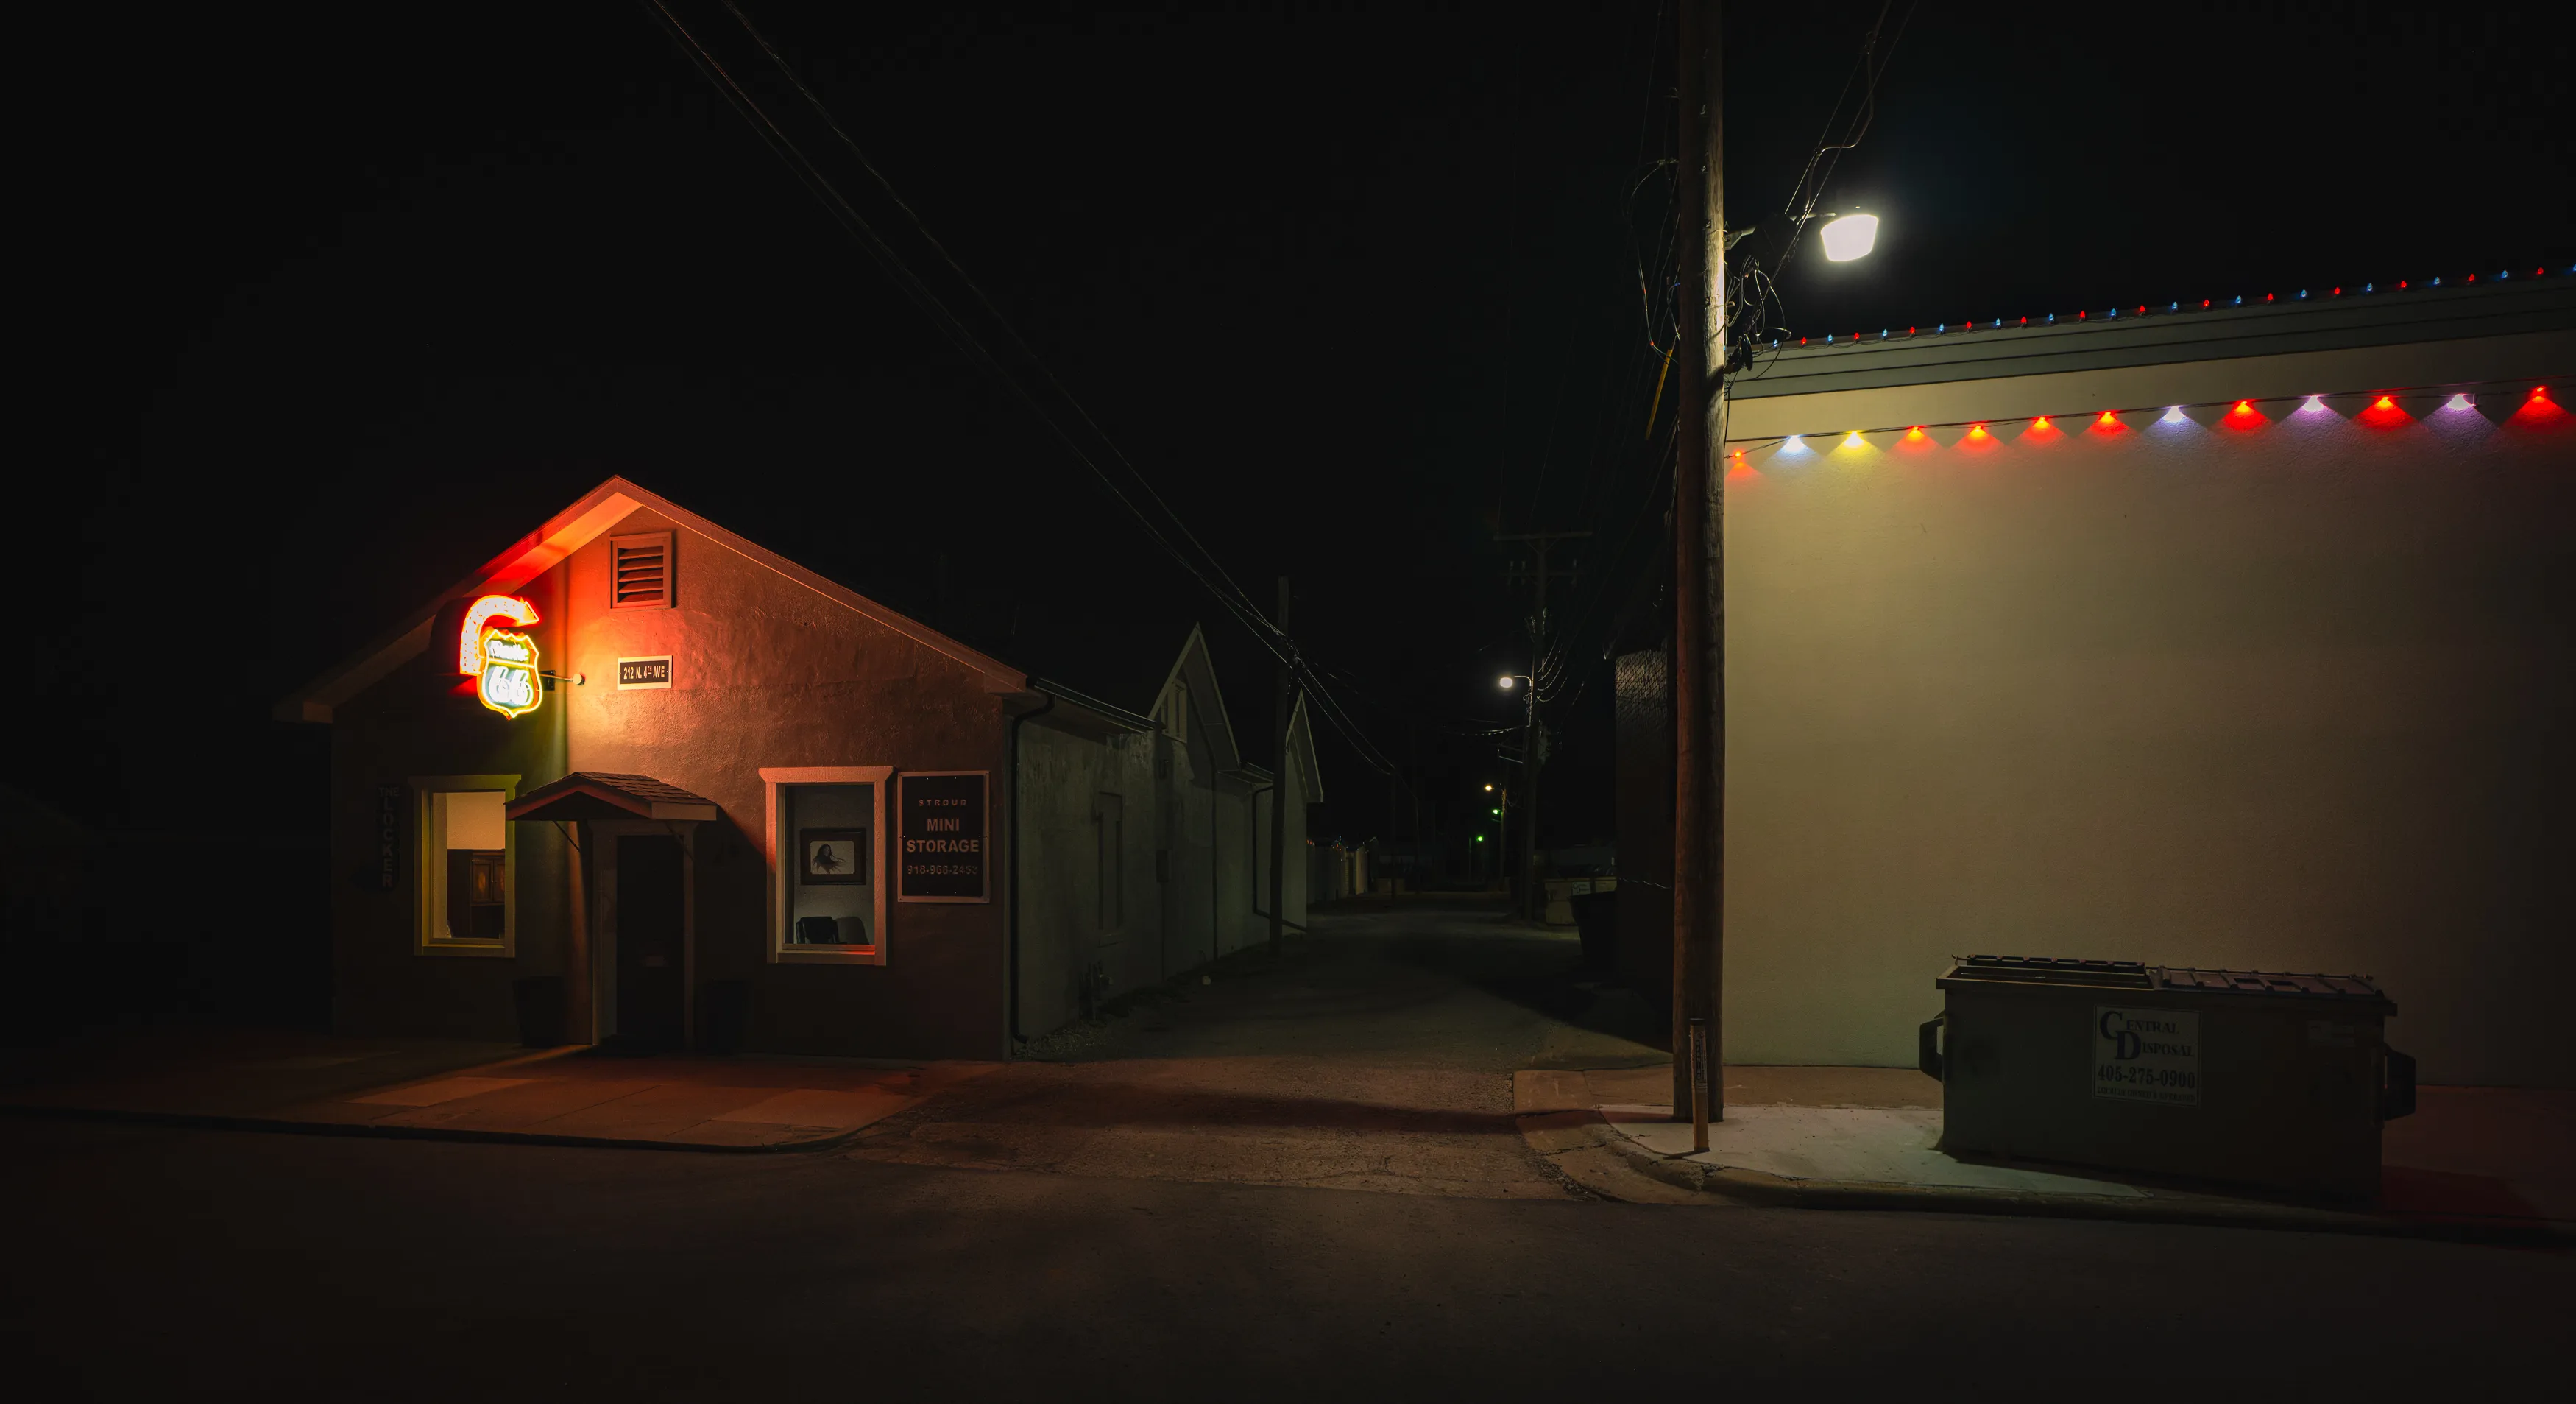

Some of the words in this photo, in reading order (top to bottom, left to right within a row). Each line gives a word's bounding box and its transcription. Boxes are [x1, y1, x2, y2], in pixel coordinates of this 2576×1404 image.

[623, 666, 634, 680] 212
[636, 666, 643, 679] N.
[653, 665, 665, 678] AVE
[488, 666, 534, 707] 66
[378, 787, 400, 797] THE
[927, 818, 960, 832] MINI
[382, 797, 394, 888] LOCKER
[906, 839, 979, 853] STORAGE
[2098, 1064, 2195, 1088] 405-275-0900
